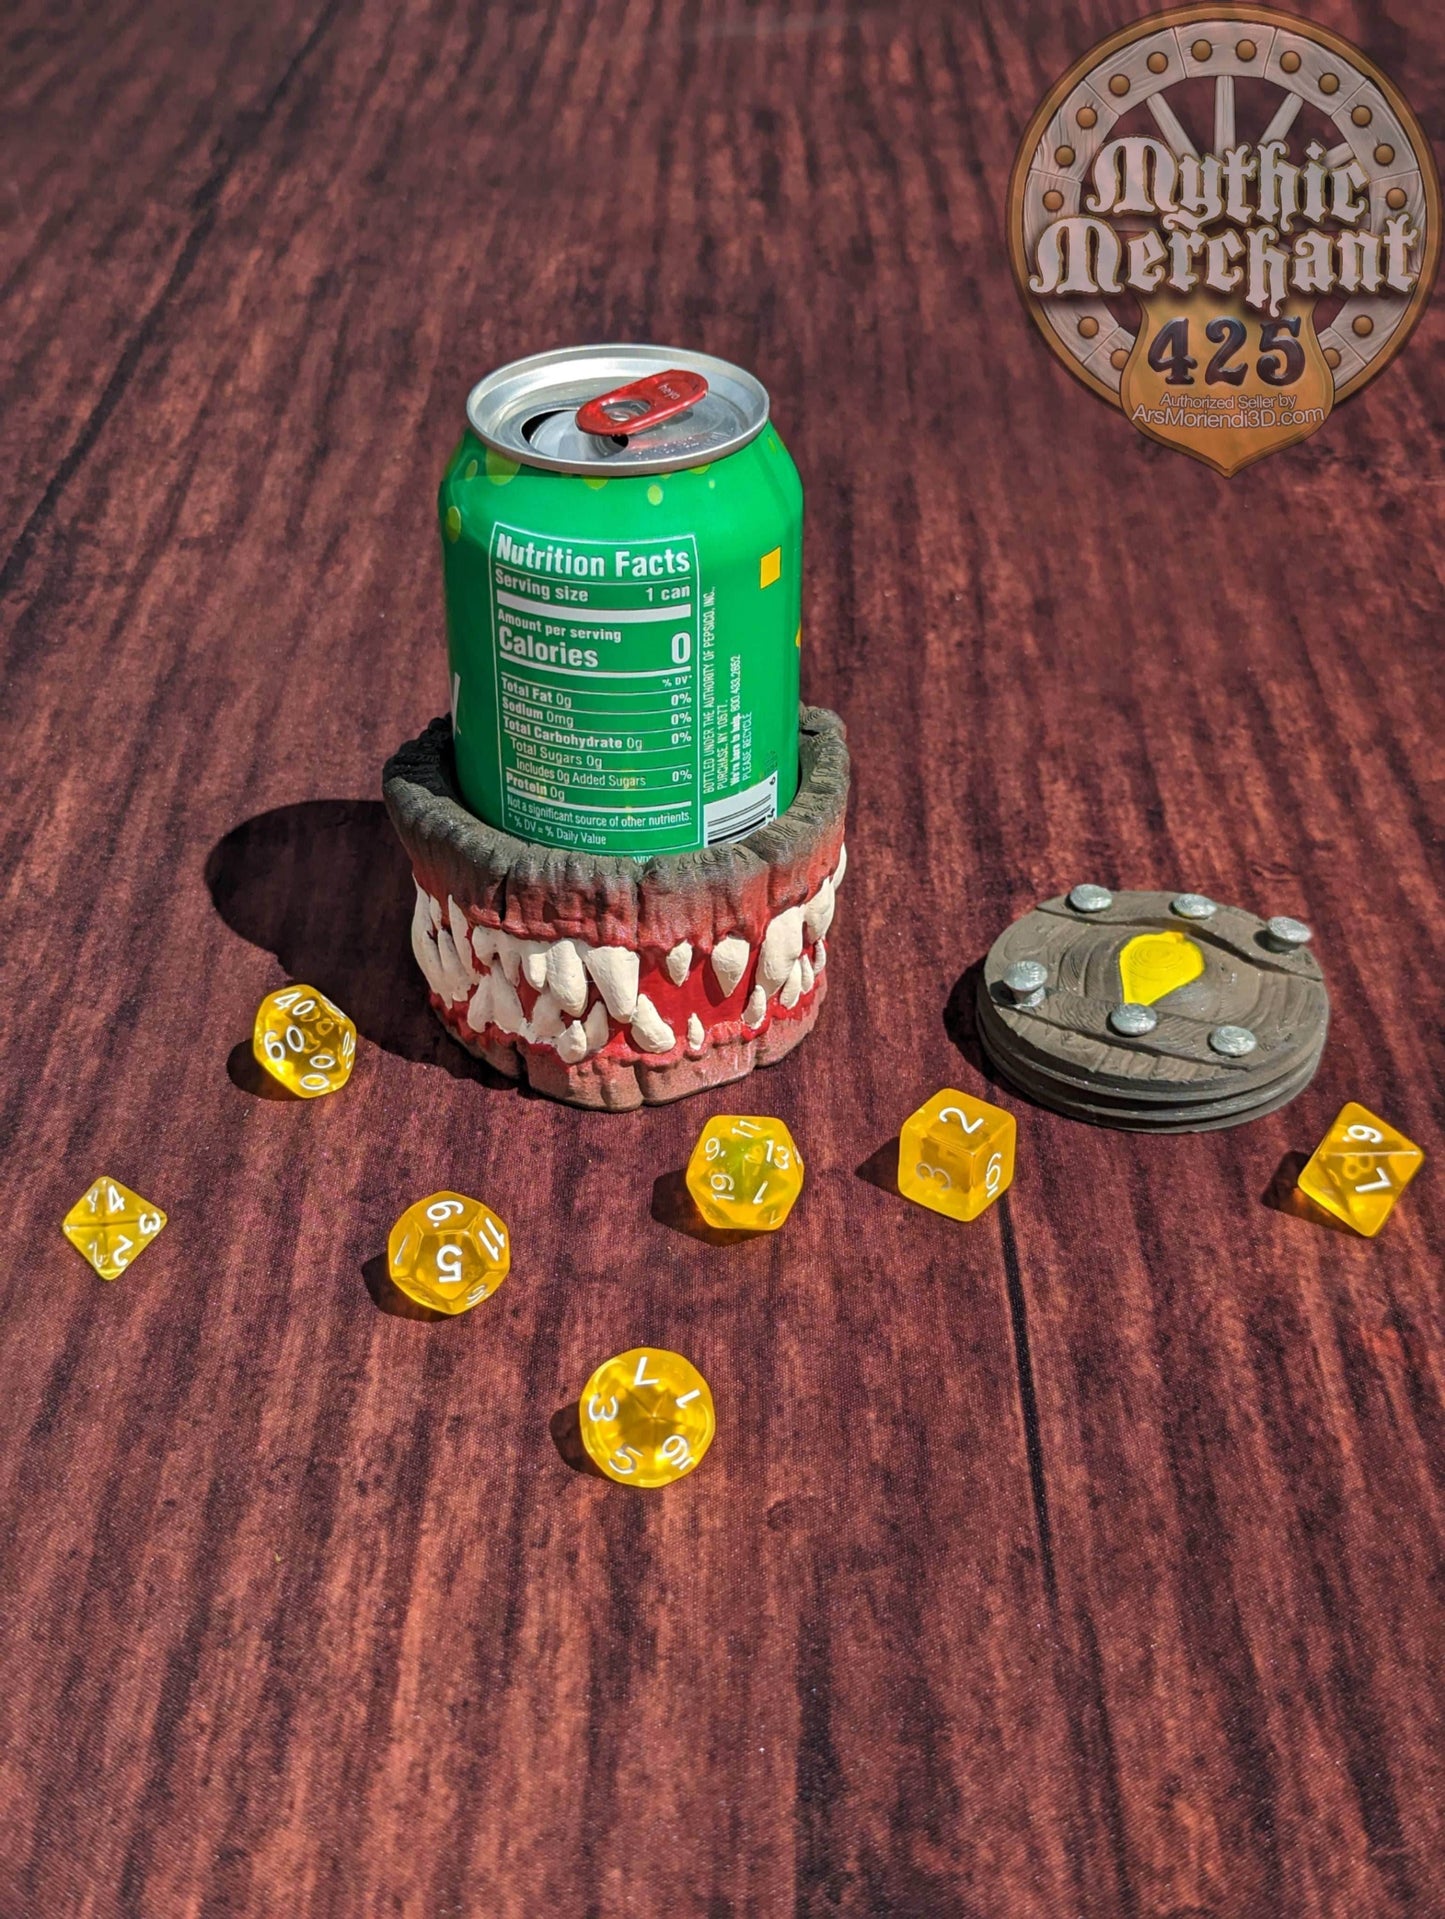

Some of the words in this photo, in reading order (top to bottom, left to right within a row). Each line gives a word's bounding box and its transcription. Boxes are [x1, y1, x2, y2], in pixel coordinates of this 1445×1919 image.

[496, 533, 605, 577] Nutrition
[615, 549, 691, 577] Facts
[496, 569, 550, 600] Serving
[555, 585, 589, 602] size
[645, 587, 653, 602] 1
[661, 585, 690, 601] can
[498, 609, 542, 632] Amount
[545, 625, 565, 637] per
[570, 628, 621, 643] serving
[499, 626, 599, 668] Calories
[671, 632, 691, 664] 0
[703, 650, 715, 661] OF
[501, 677, 529, 697] Total
[532, 687, 553, 703] Fat
[556, 693, 572, 709] 0g
[671, 692, 692, 706] 0%
[703, 663, 715, 708] AUTHORITY
[502, 696, 543, 720] Sodium
[546, 711, 574, 729] 0mg
[671, 712, 692, 726] 0%
[703, 710, 715, 728] THE
[503, 715, 531, 736] Total
[534, 726, 622, 749] Carbohydrate
[626, 737, 643, 750] 0g
[671, 731, 692, 745] 0%
[703, 727, 715, 756] UNDER
[717, 732, 728, 743] NY
[742, 711, 753, 749] RECYCLE
[510, 736, 537, 756] Total
[540, 746, 583, 765] Sugars
[586, 755, 603, 770] 0g
[742, 750, 753, 781] PLEASE
[506, 771, 548, 796] Protein
[550, 786, 565, 802] 0g
[516, 757, 555, 779] Includes
[557, 769, 570, 785] 0g
[572, 772, 606, 786] Added
[608, 775, 647, 789] Sugars
[672, 769, 693, 783] 0%
[703, 757, 715, 794] BOTTLED
[507, 794, 521, 807] Not
[521, 801, 528, 812] a
[528, 803, 573, 824] significant
[575, 815, 607, 827] source
[609, 816, 619, 827] of
[621, 815, 646, 828] other
[649, 811, 693, 826] nutrients.
[524, 819, 537, 832] DV
[556, 828, 578, 844] Daily
[580, 832, 607, 845] Value
[264, 1024, 304, 1062] 60
[938, 1107, 984, 1134] 2
[766, 1139, 790, 1170] 13
[107, 1185, 126, 1214] 4
[436, 1244, 463, 1283] 5
[587, 1394, 618, 1422] 3
